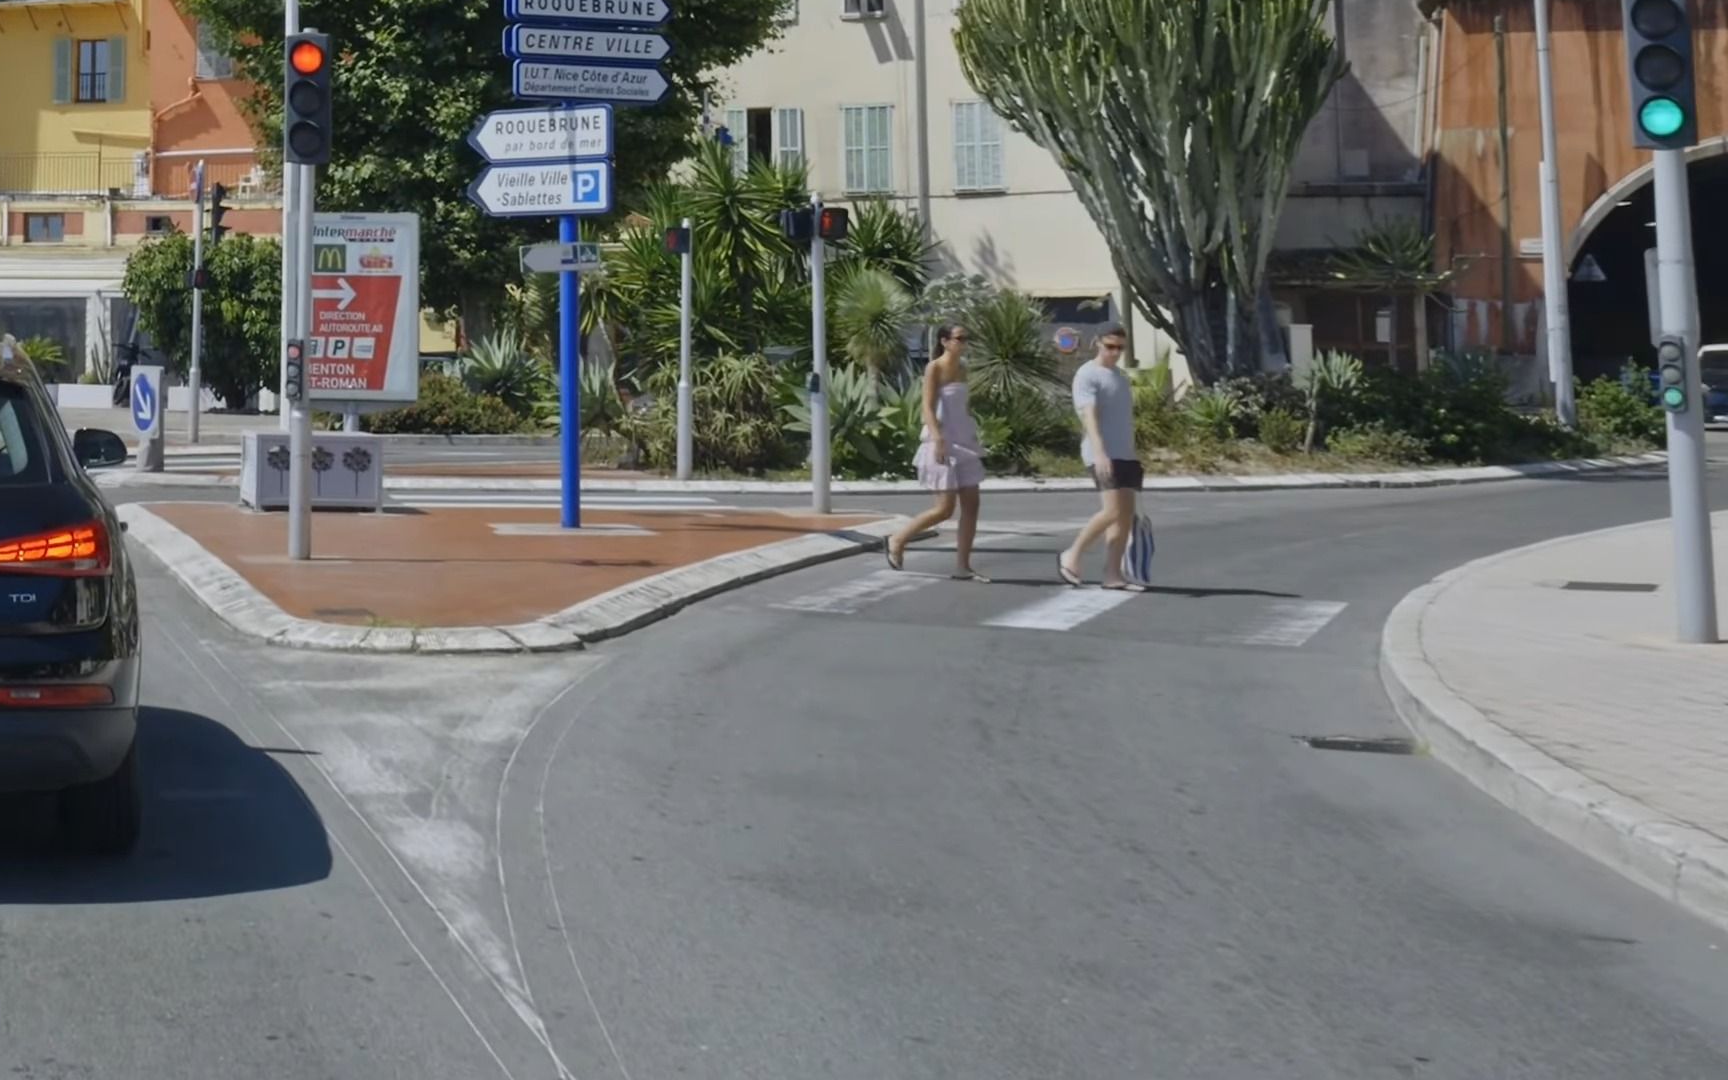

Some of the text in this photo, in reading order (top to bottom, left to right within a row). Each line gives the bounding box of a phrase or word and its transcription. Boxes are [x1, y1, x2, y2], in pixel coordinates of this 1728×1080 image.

[525, 33, 654, 54] CENTRE VILLE
[553, 68, 580, 81] Nice
[581, 69, 609, 83] Côte
[495, 115, 601, 135] ROQUEBRUNE
[504, 141, 524, 154] par
[529, 139, 555, 151] bord
[579, 138, 602, 149] mer
[497, 170, 569, 188] Vieille Ville
[575, 173, 595, 201] P
[313, 225, 397, 238] Intermarché
[319, 311, 366, 320] DIRECTION
[319, 323, 371, 333] AUTOROUTE
[309, 363, 355, 375] ENTON
[310, 377, 367, 389] T-ROMAN
[8, 593, 37, 604] TDI
